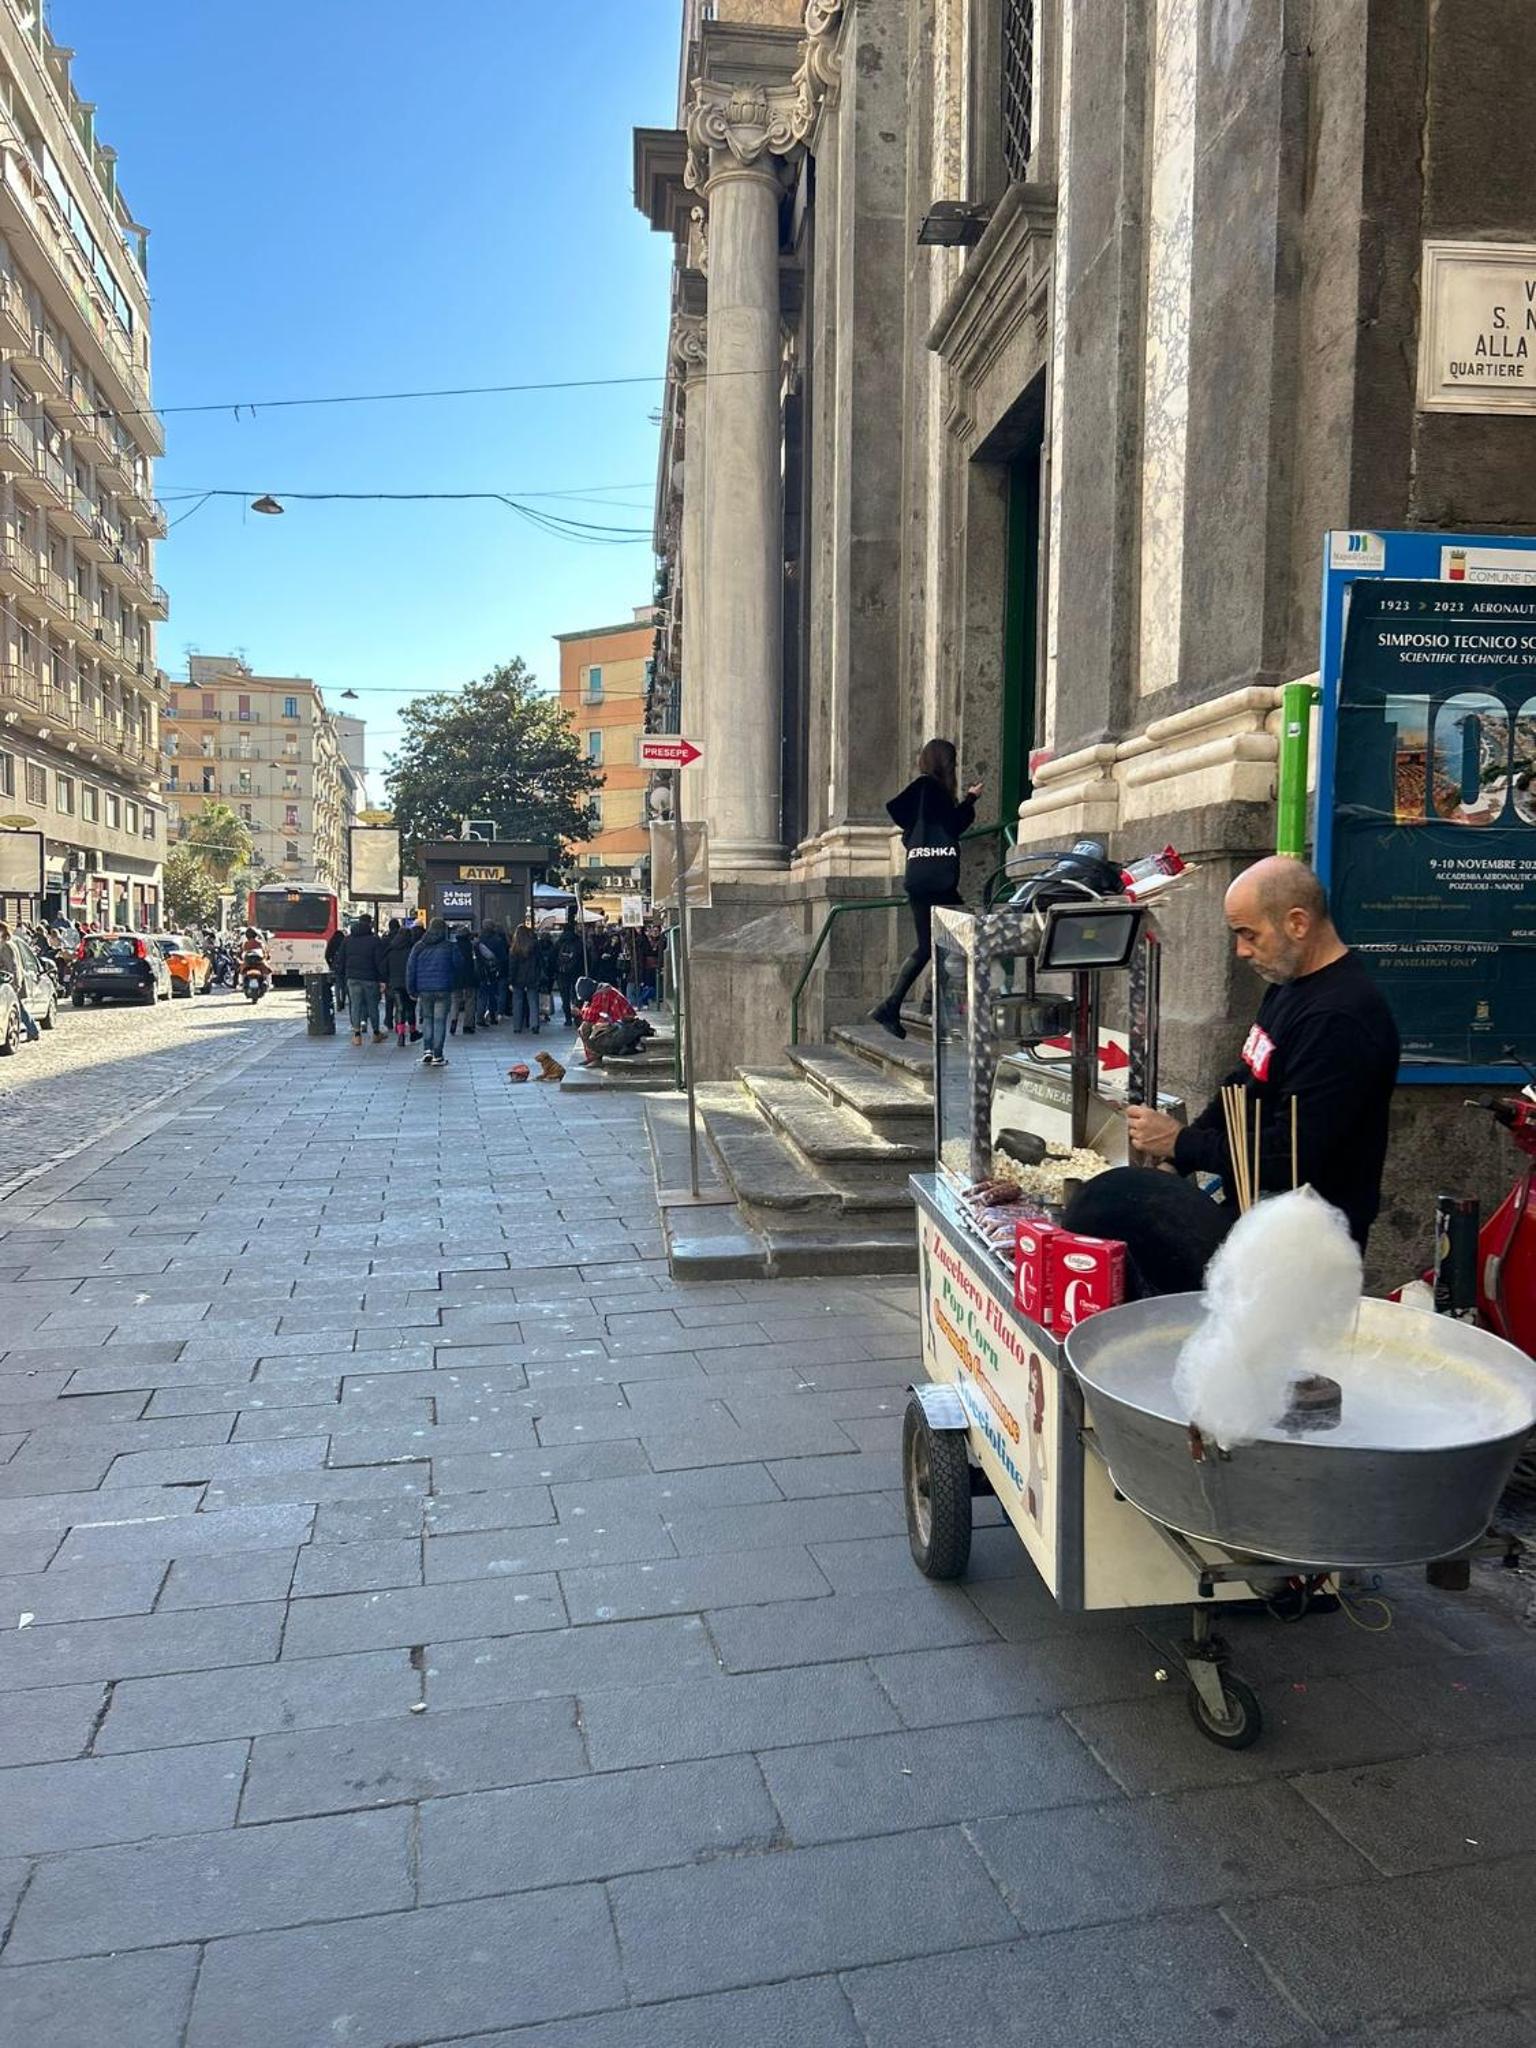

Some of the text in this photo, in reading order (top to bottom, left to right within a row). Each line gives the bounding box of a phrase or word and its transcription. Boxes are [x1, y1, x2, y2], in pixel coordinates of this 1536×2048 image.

[1493, 306, 1510, 330] S.
[1475, 334, 1528, 358] ALLA
[1450, 361, 1524, 379] QUARTIERE
[1468, 571, 1521, 584] COMUNE
[1380, 600, 1410, 611] 1923
[1434, 601, 1465, 612] 2023
[1378, 633, 1449, 648] SIMPOSIO
[1453, 635, 1517, 649] TECNICO
[1399, 652, 1536, 666] SCIENTIFIC TECHNICAL SY
[645, 747, 689, 757] PRESEPE
[1430, 859, 1455, 869] 9-10
[1457, 859, 1516, 869] NOVEMBRE
[467, 868, 499, 879] ATM
[443, 898, 472, 906] CASH
[1467, 943, 1499, 953] INVITO
[933, 1232, 1025, 1365] Zucchero Filato
[943, 1276, 999, 1372] Pop Corn
